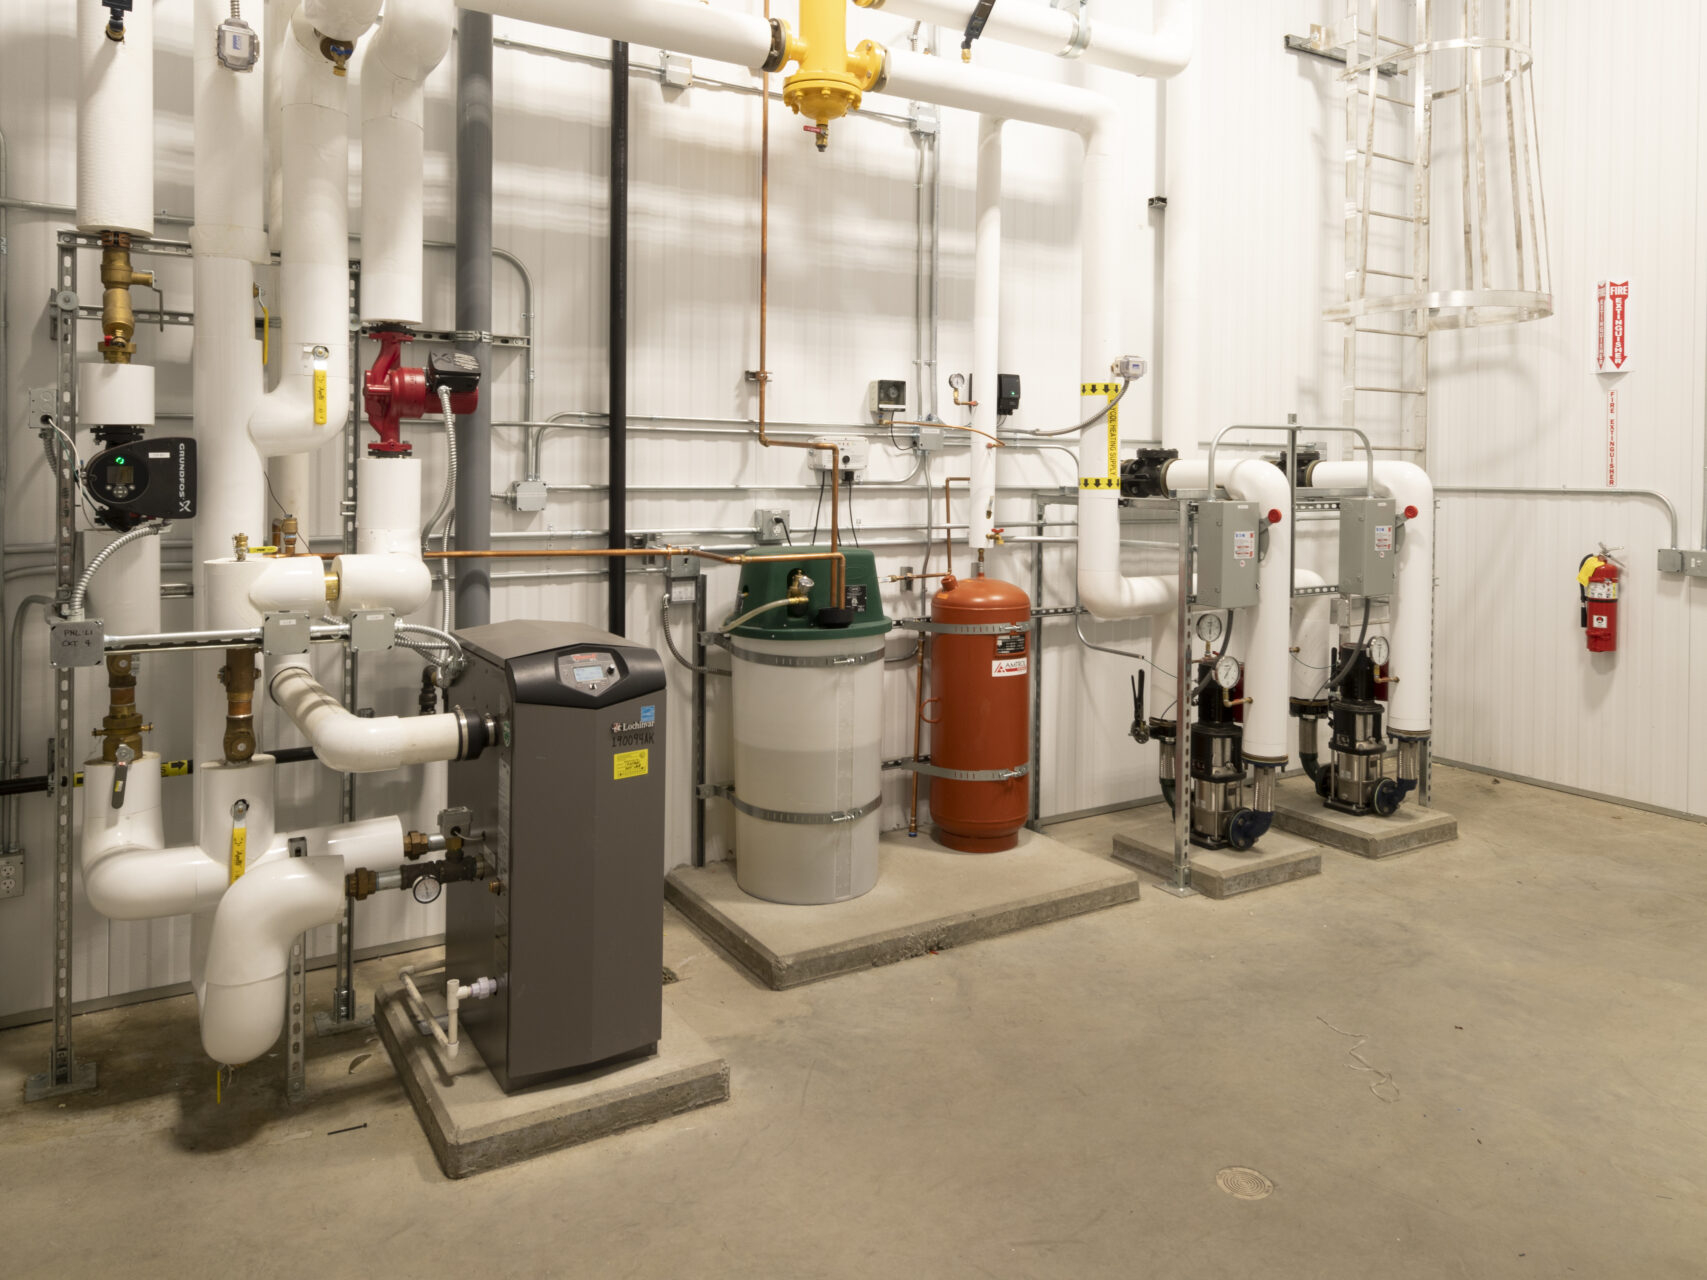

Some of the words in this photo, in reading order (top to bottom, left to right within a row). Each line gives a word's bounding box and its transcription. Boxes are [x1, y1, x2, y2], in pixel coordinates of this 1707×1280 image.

[1610, 285, 1628, 296] FIRE
[1614, 297, 1623, 364] EXTINGUISHER
[1109, 424, 1117, 451] HEATING
[1109, 452, 1117, 476] SUPPLY
